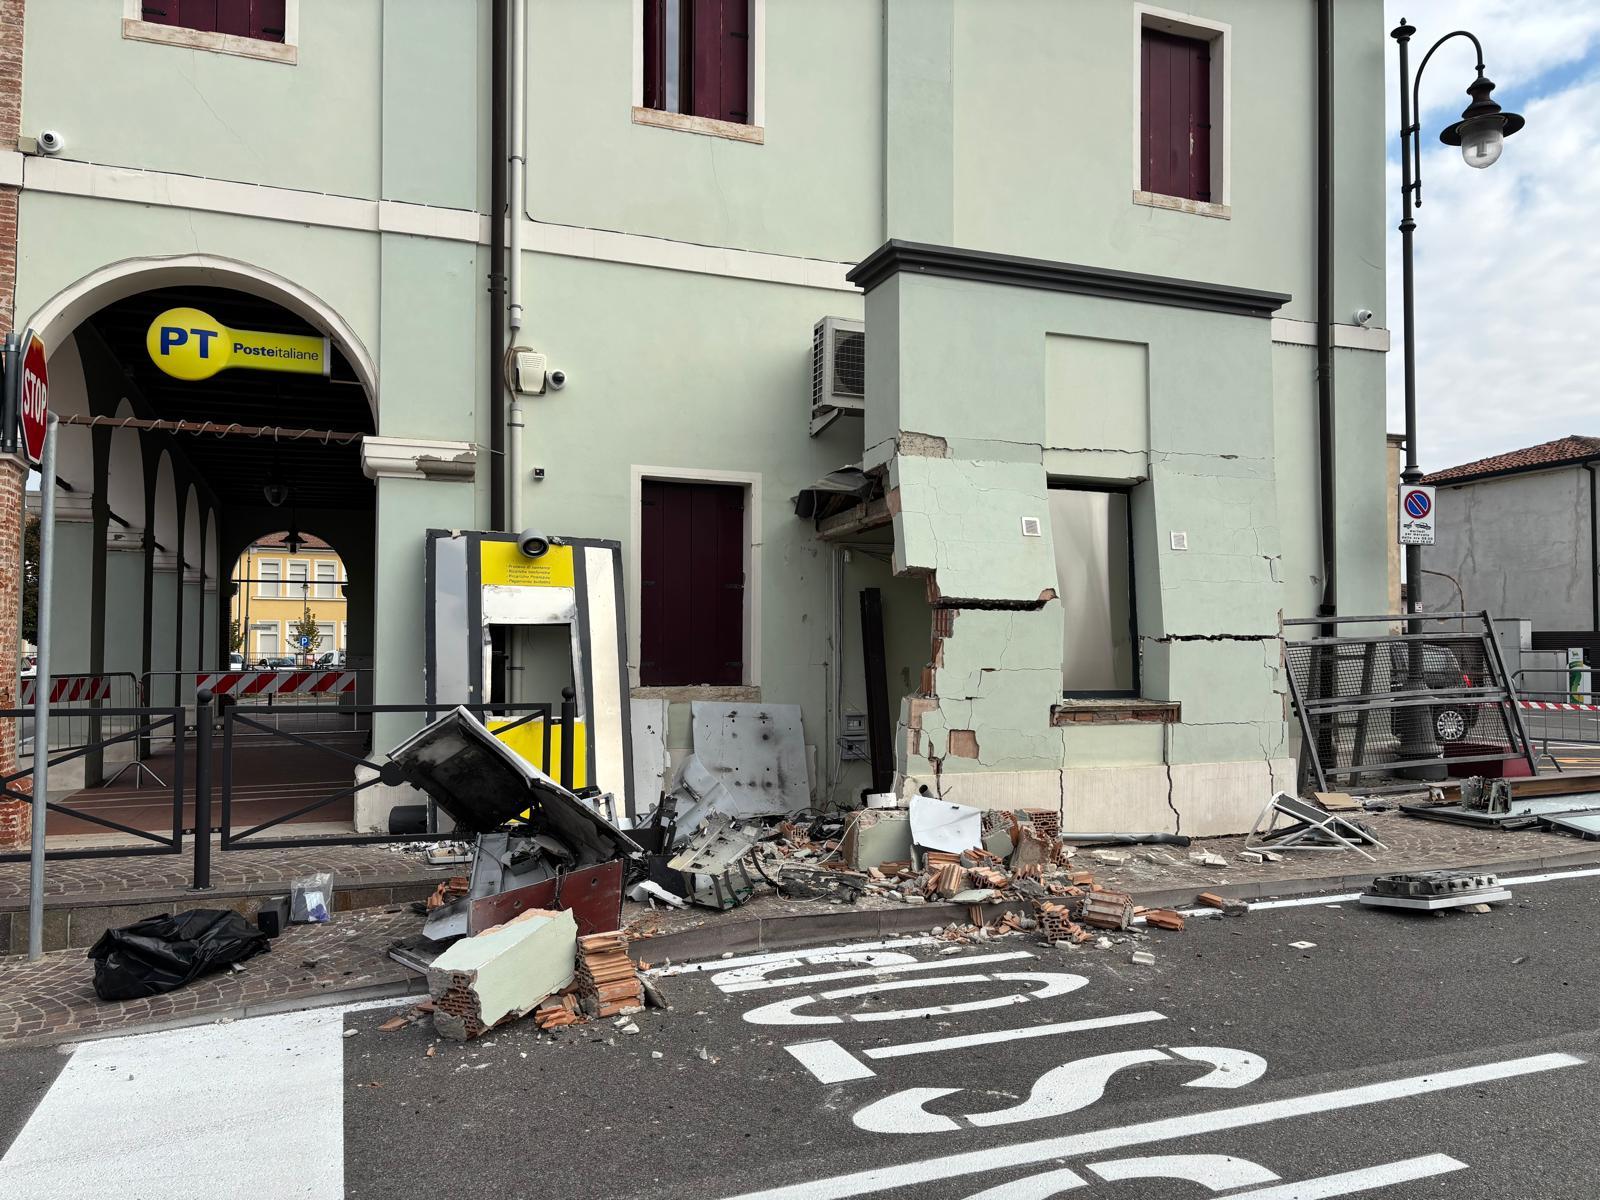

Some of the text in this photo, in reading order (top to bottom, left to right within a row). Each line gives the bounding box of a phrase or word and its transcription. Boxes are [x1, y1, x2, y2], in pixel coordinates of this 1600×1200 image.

[160, 326, 218, 359] PT
[24, 367, 47, 426] STOP
[710, 951, 1268, 1134] STOP
